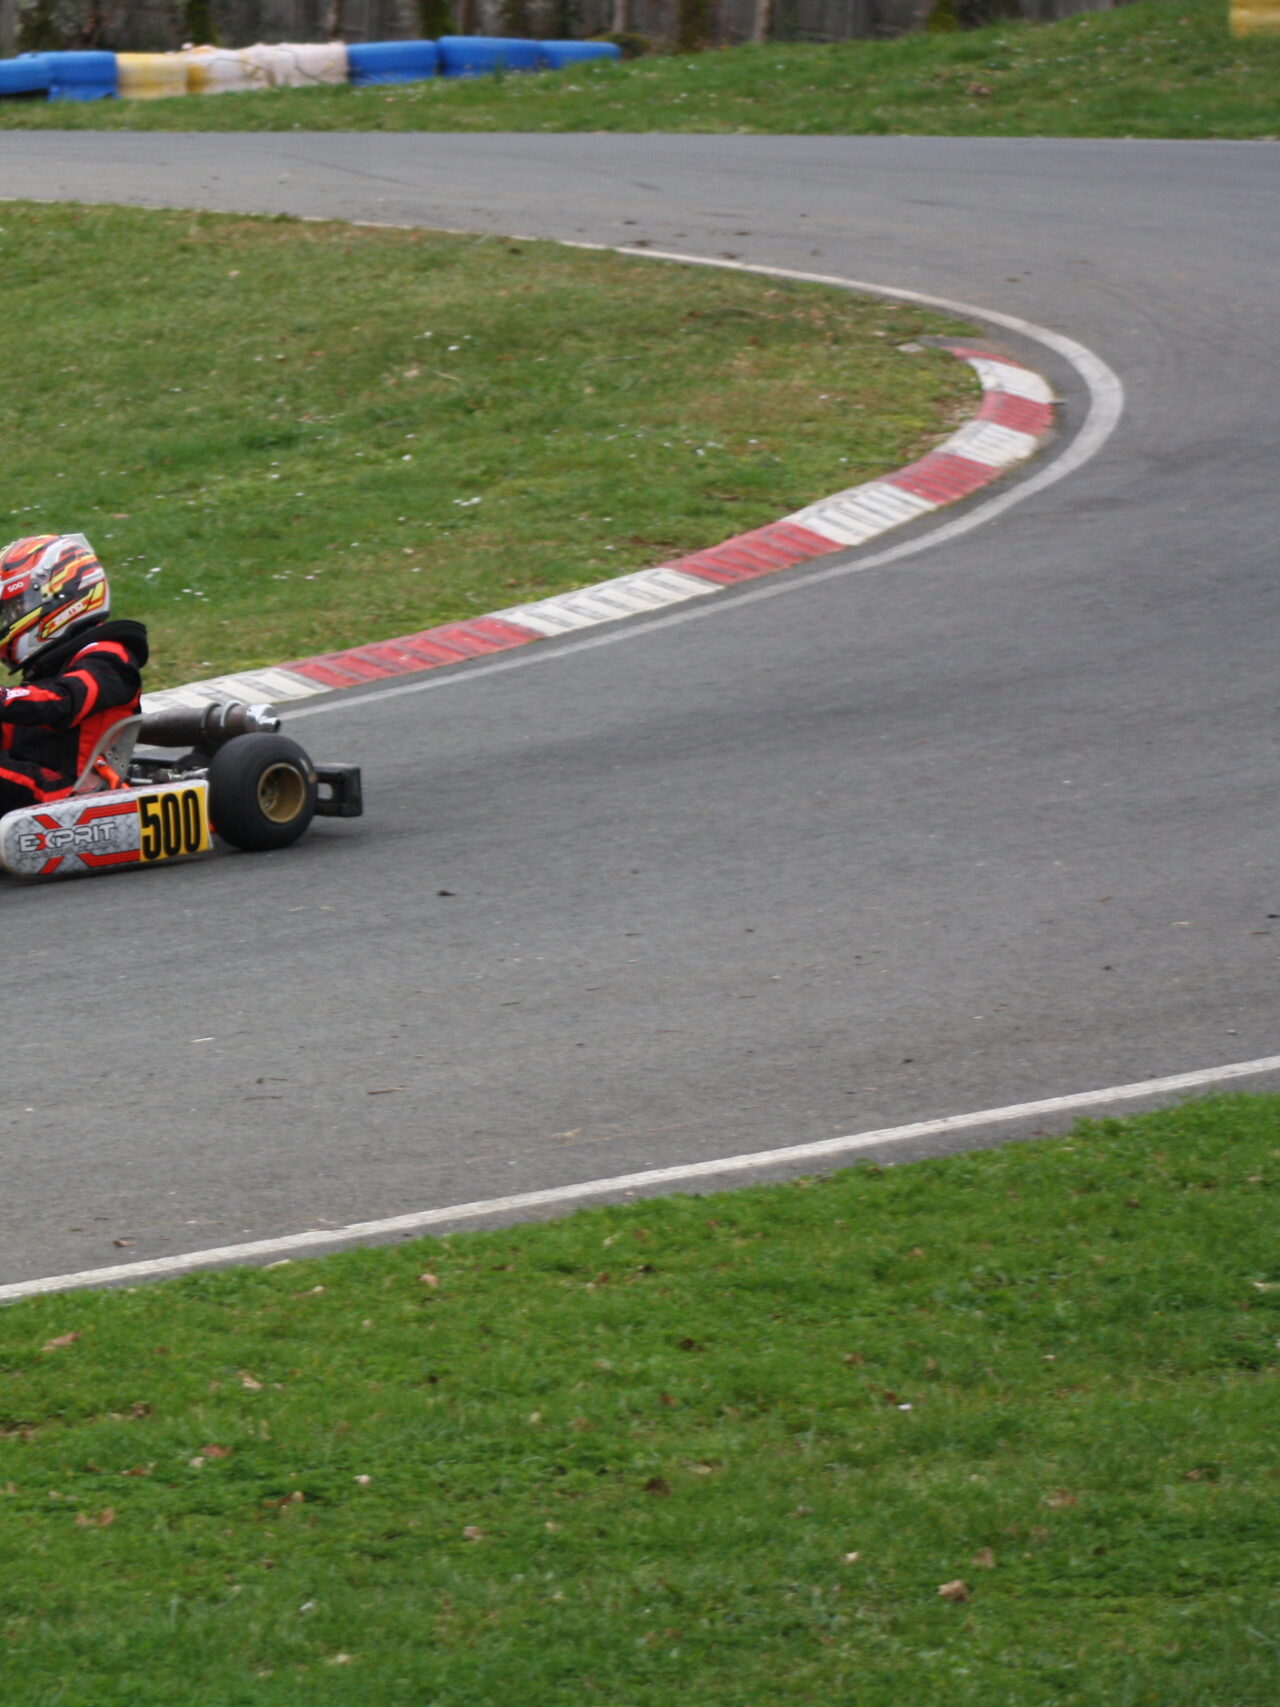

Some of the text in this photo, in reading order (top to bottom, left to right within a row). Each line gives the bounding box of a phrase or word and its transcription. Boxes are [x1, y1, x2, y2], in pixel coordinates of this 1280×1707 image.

[7, 581, 24, 593] 500
[18, 822, 116, 853] EXPRIT
[140, 790, 202, 861] 500
